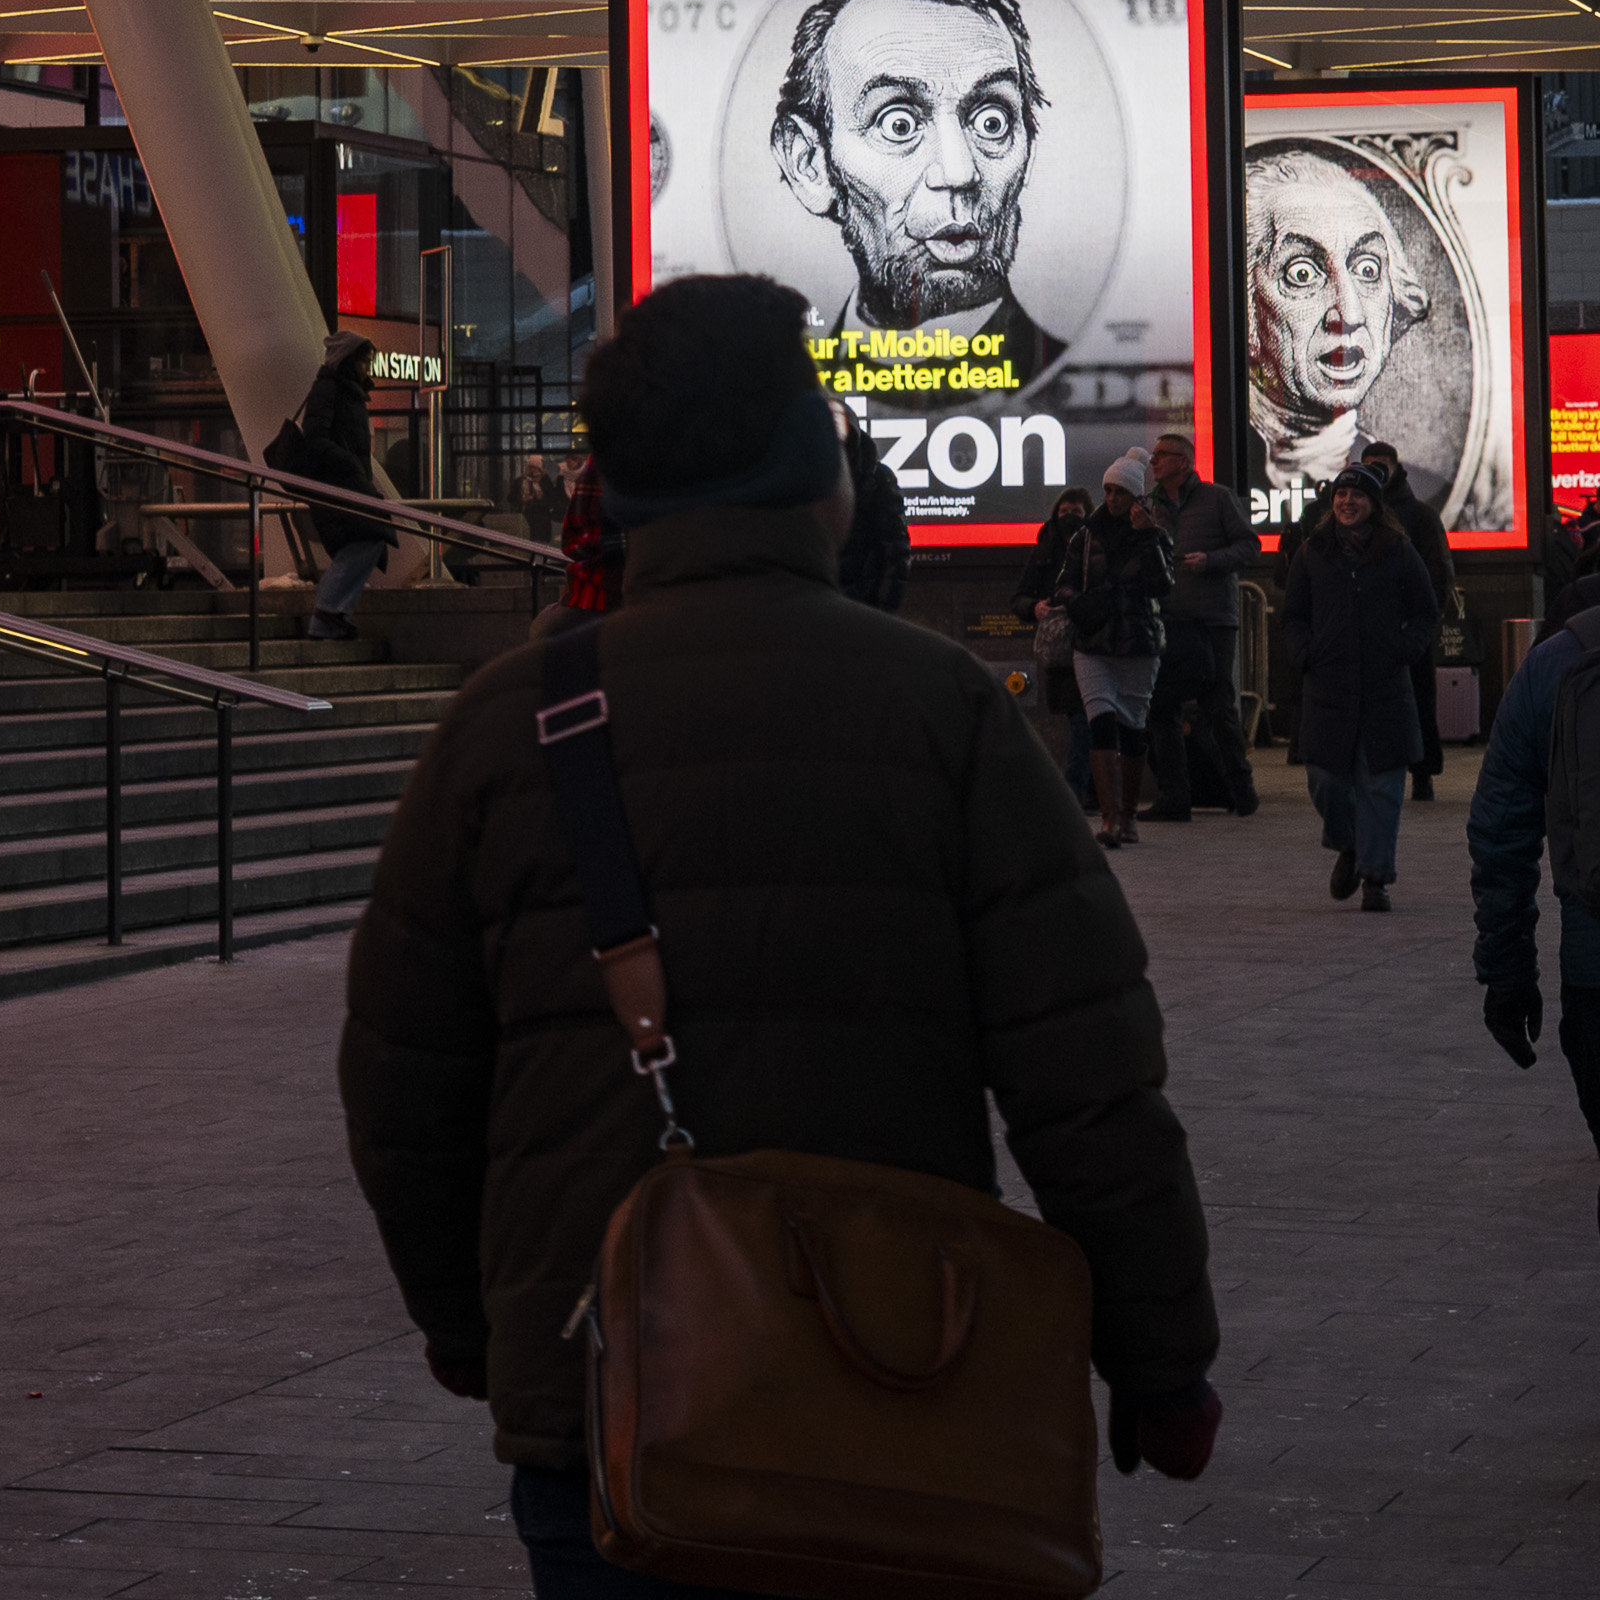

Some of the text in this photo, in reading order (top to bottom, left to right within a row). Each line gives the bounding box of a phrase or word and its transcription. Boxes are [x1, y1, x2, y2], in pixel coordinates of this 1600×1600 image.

[646, 0, 704, 34] 07
[808, 306, 825, 327] t.
[841, 328, 969, 359] T-Mobile
[971, 334, 1005, 356] or
[367, 351, 441, 383] NN STATON
[833, 370, 853, 392] a
[855, 363, 946, 391] better
[948, 359, 1020, 388] deal.
[1568, 431, 1597, 443] today
[1584, 422, 1596, 431] or
[1441, 623, 1461, 636] live
[1444, 644, 1464, 658] life
